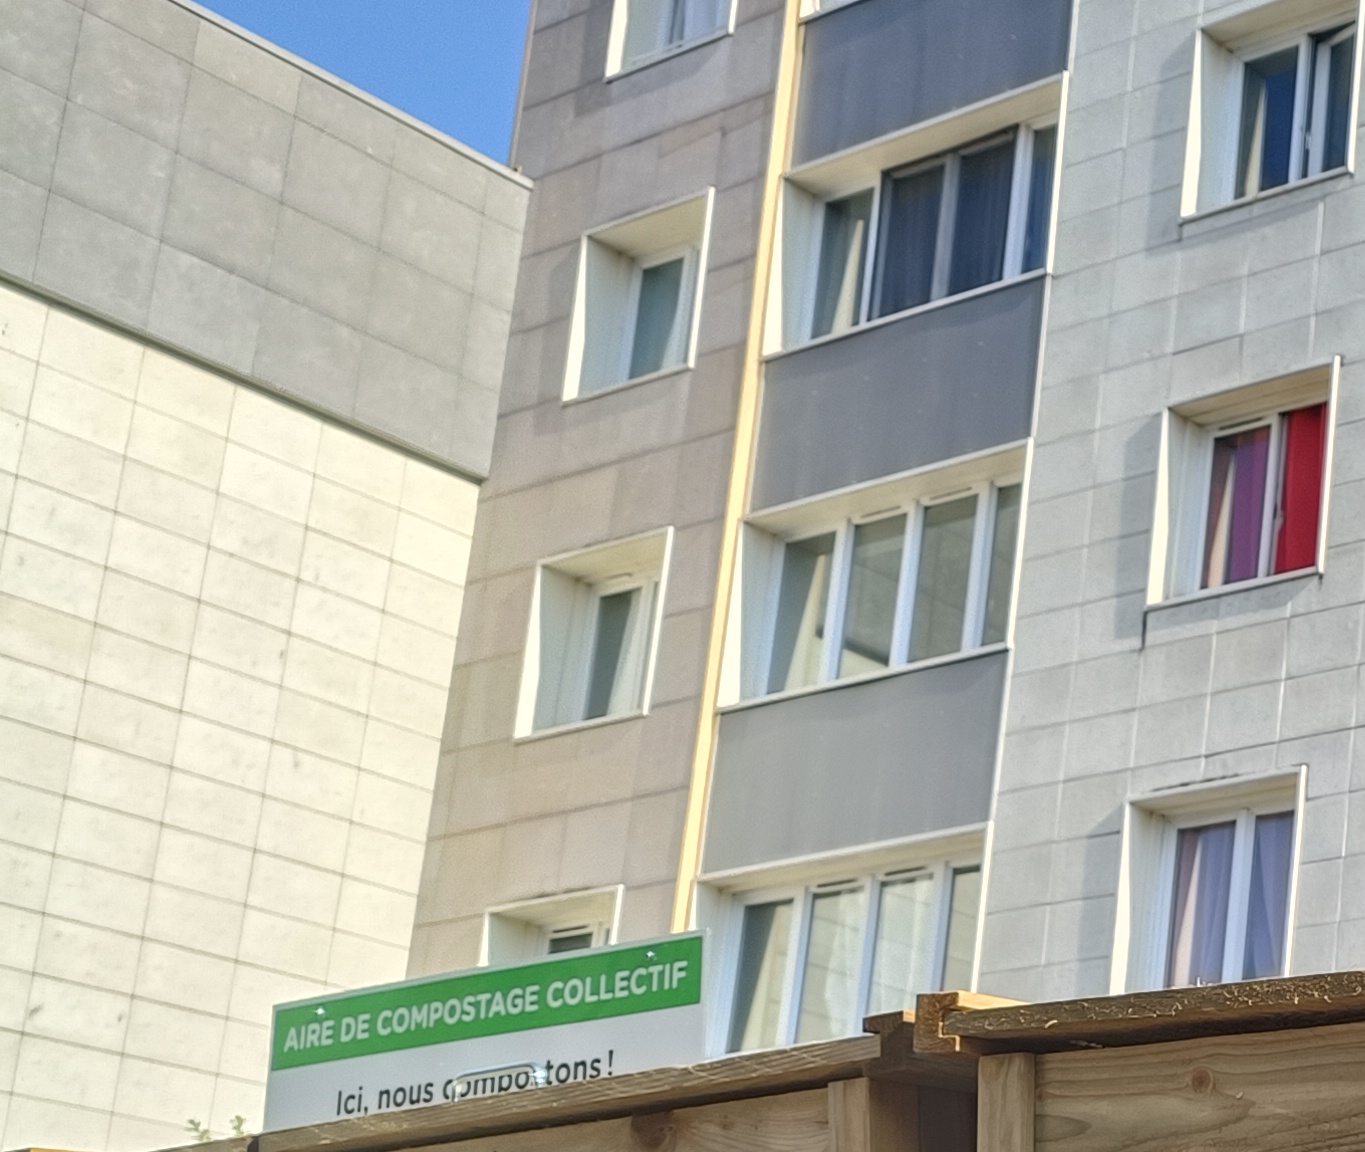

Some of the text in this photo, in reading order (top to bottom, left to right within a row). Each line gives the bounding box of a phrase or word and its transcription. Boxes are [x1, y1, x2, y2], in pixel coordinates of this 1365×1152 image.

[283, 960, 688, 1052] AIRE DE COMPOSTAGE COLLECTIF
[336, 1085, 368, 1116] Ici,
[377, 1082, 433, 1109] nous
